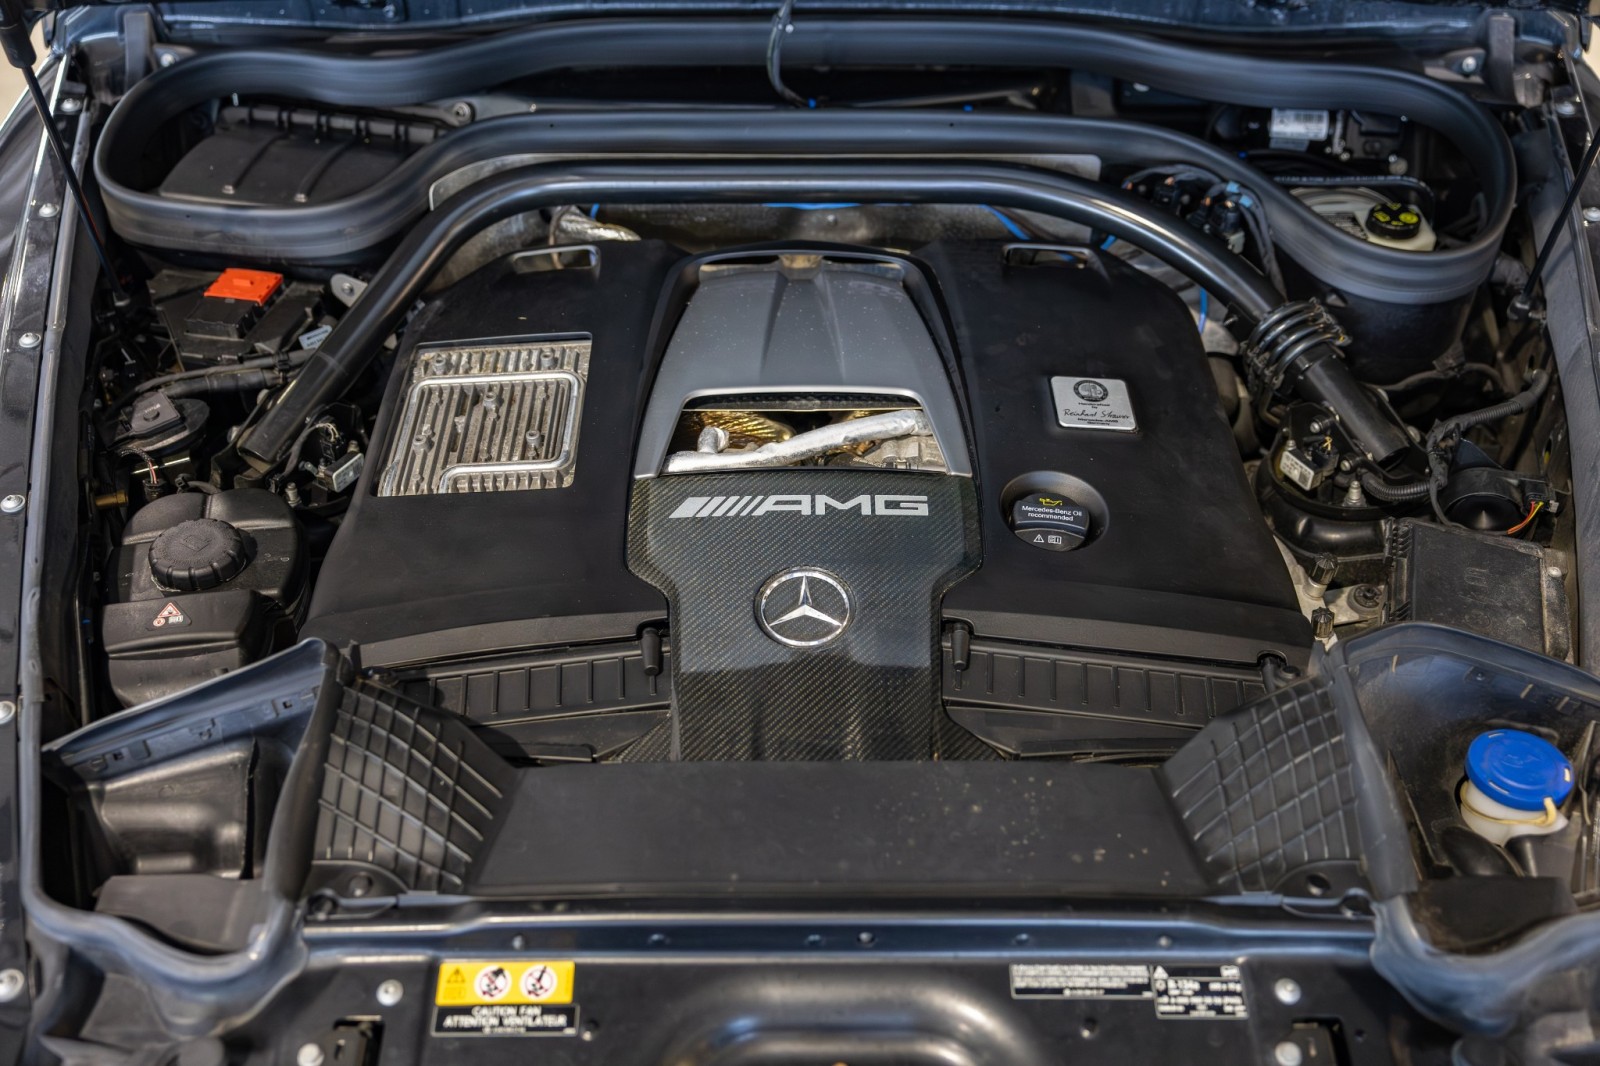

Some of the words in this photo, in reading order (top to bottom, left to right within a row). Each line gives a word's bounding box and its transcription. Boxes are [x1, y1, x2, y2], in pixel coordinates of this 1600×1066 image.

[751, 494, 929, 516] AMG
[1021, 505, 1072, 516] Mercedes-Benz
[1027, 511, 1074, 521] recommended
[443, 1015, 500, 1028] ATTENTION
[501, 1014, 568, 1028] VENTILATEUR
